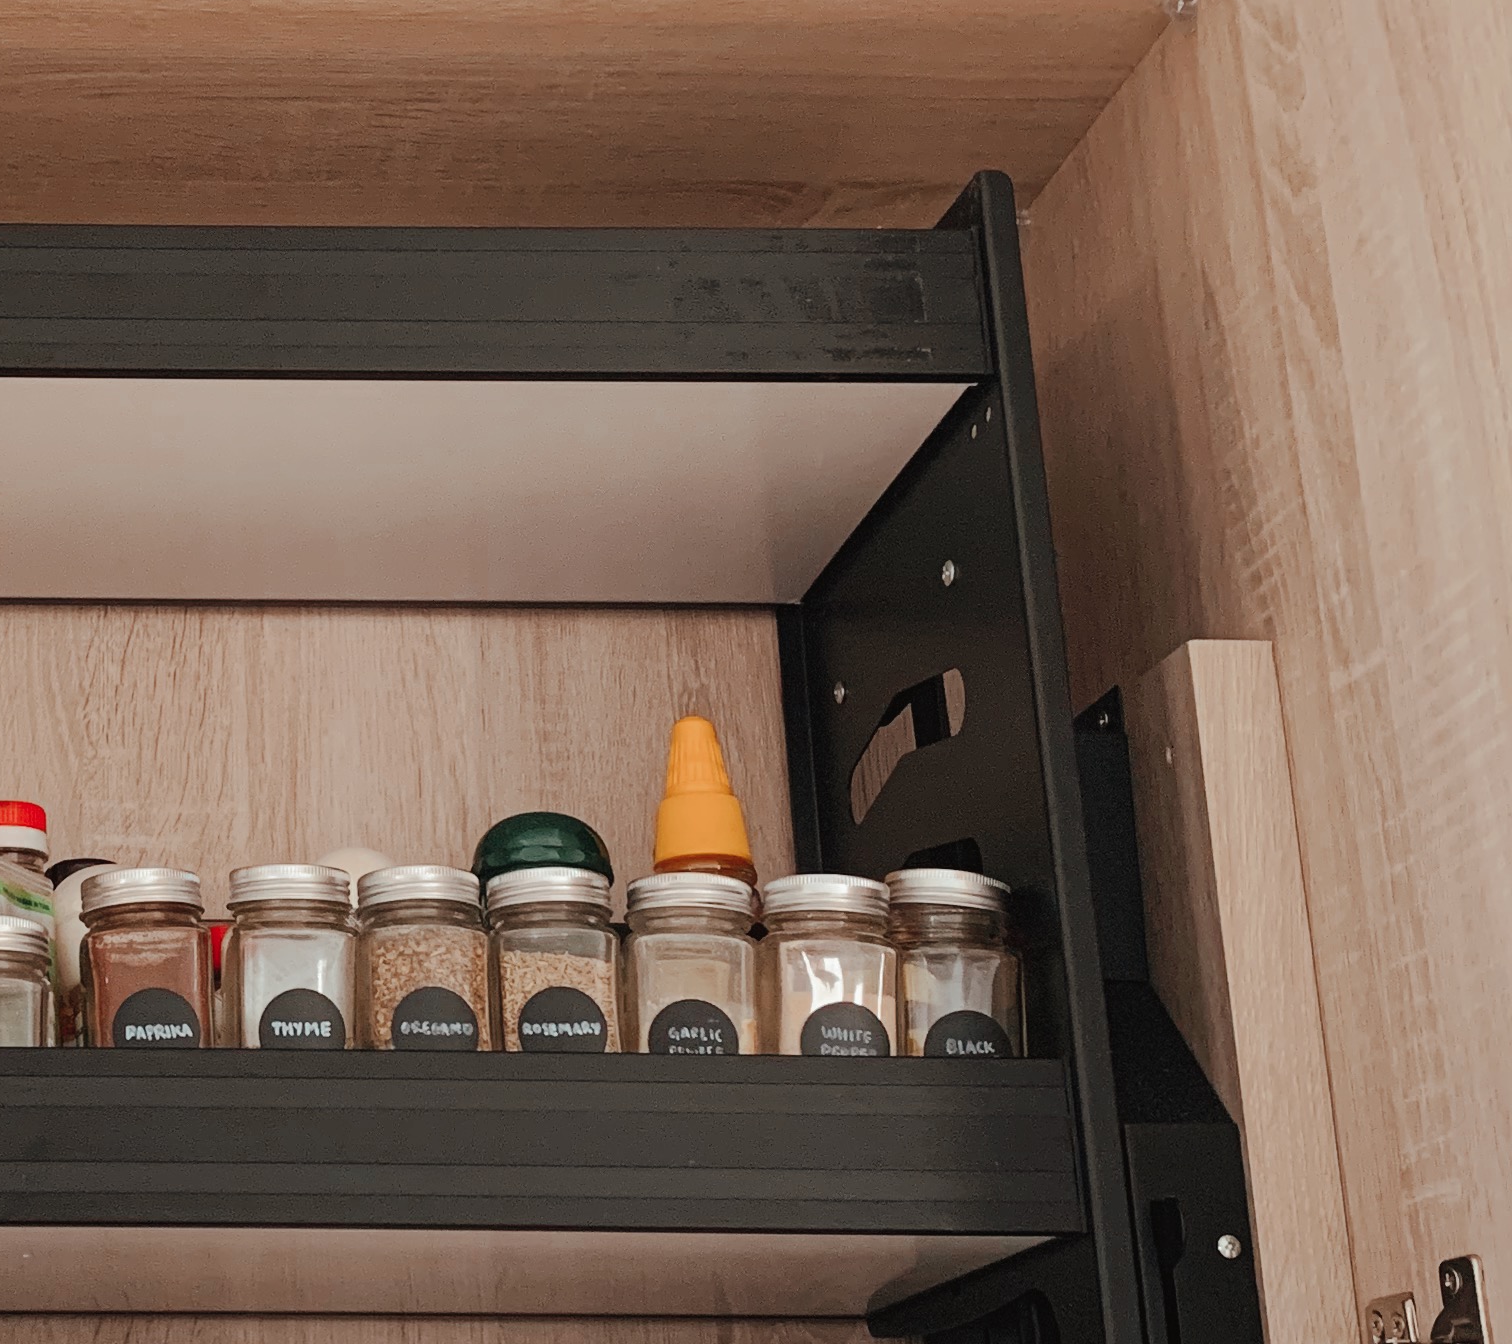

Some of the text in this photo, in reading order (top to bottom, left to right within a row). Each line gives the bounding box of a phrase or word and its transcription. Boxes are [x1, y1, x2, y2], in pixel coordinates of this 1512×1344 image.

[125, 1023, 193, 1041] PAPRIKA
[271, 1020, 332, 1038] THYME
[400, 1019, 474, 1037] OREGANO
[521, 1020, 602, 1038] ROSEMARY
[667, 1025, 723, 1043] GARLIC
[820, 1025, 873, 1044] WHITE
[945, 1038, 996, 1055] BLACK
